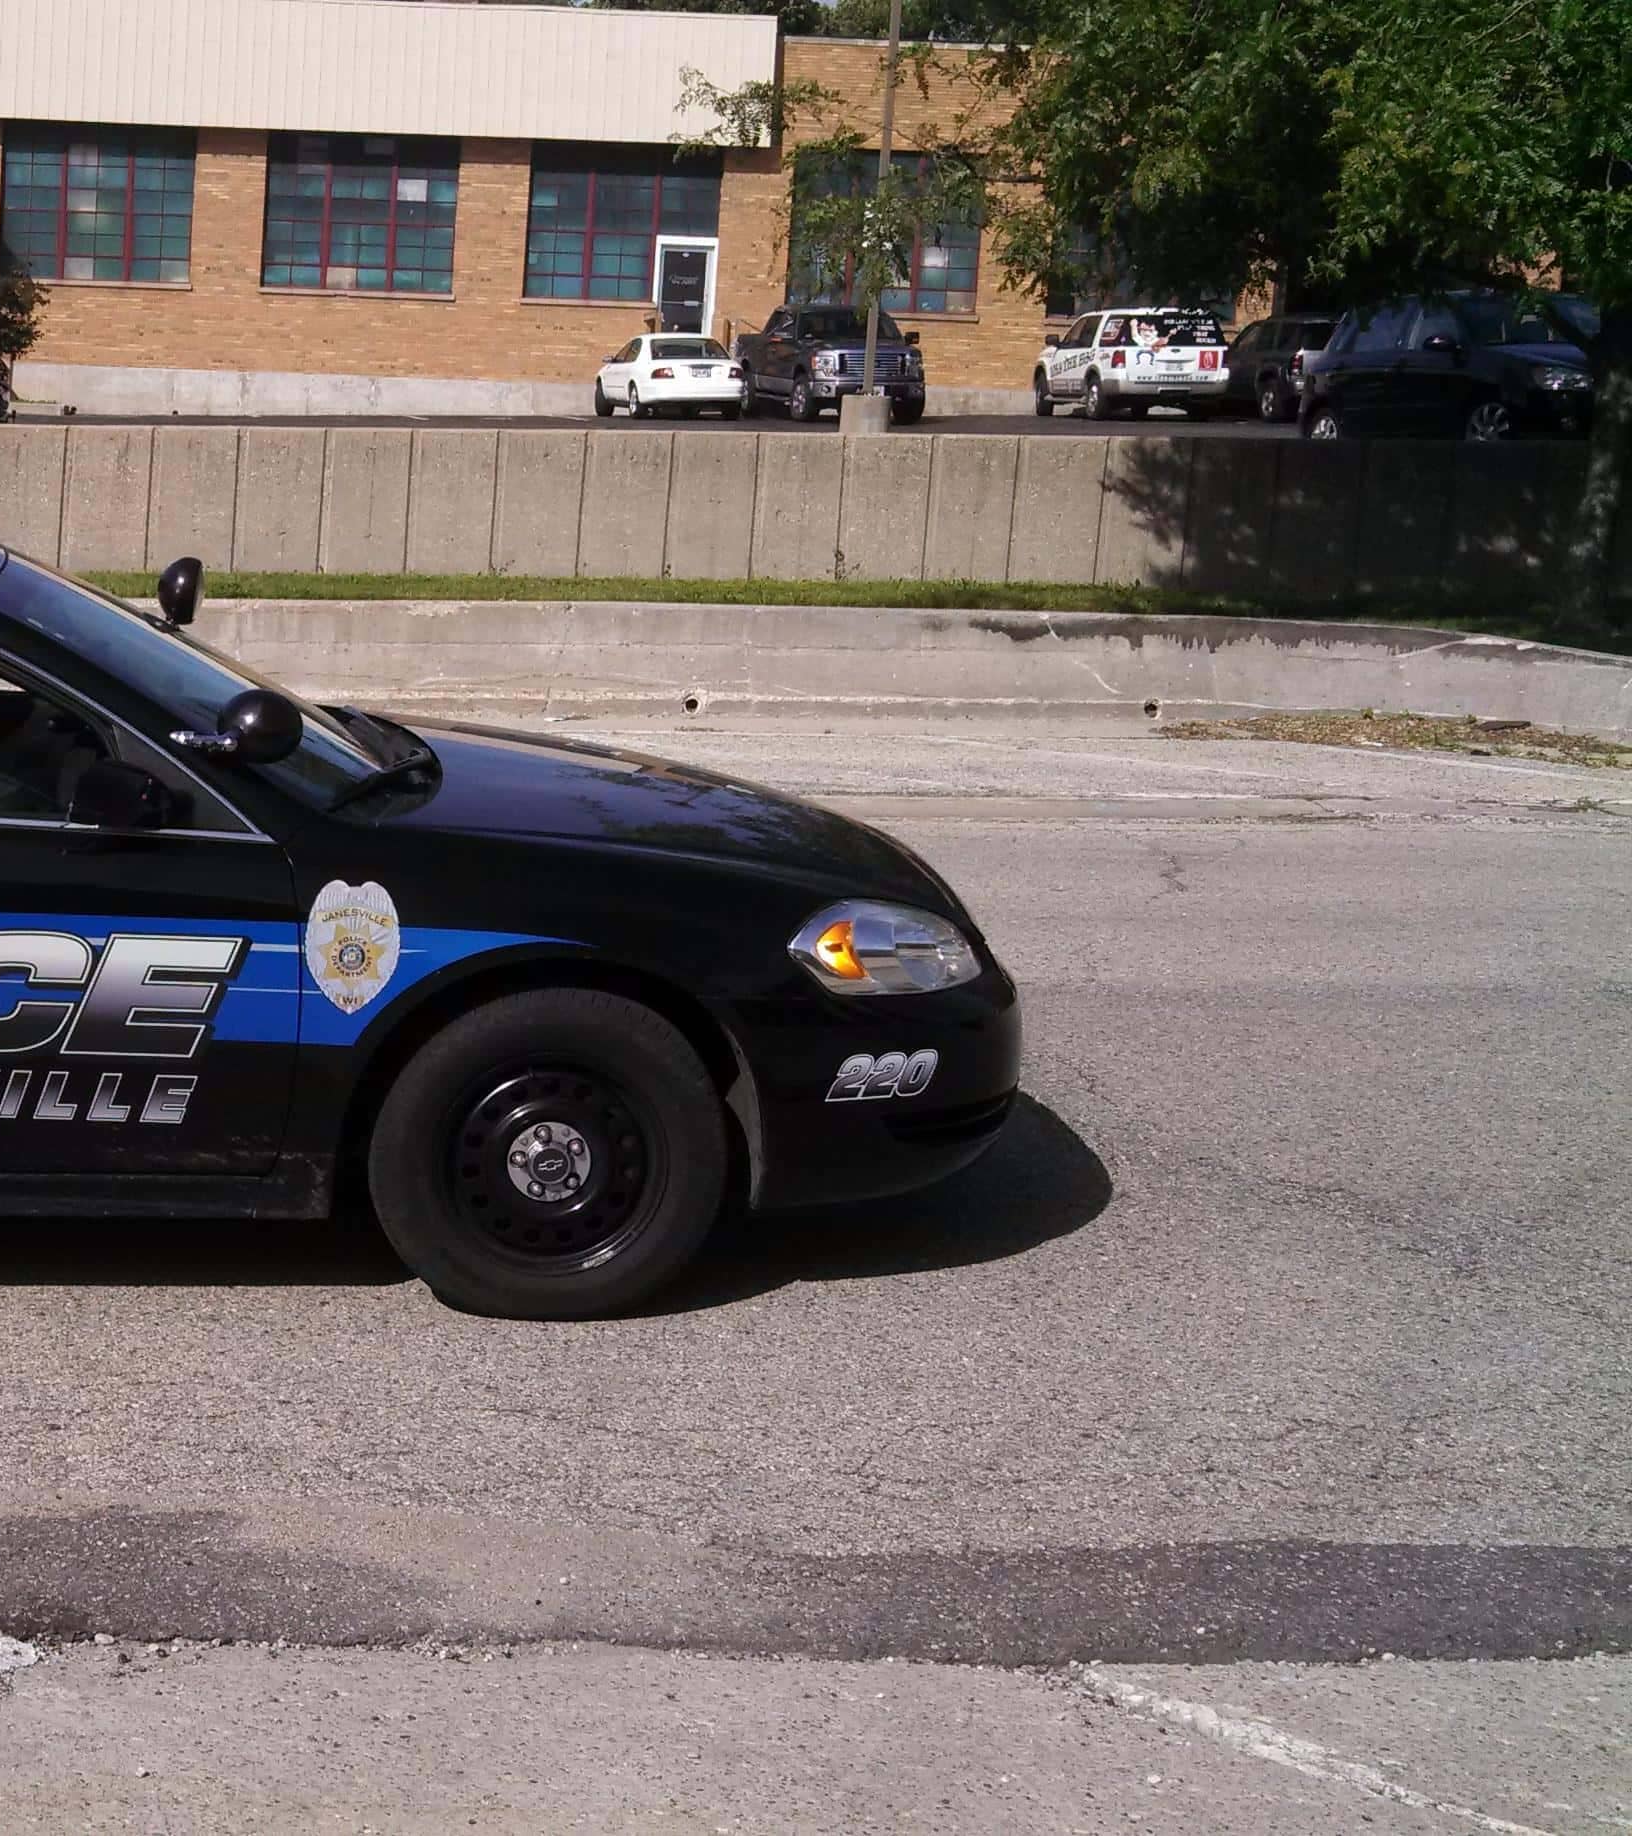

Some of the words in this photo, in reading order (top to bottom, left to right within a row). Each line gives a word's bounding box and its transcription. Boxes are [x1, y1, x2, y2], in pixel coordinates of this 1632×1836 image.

[322, 908, 388, 927] JANESVILLE
[338, 936, 367, 947] POLICE
[331, 955, 372, 977] DEPARTMENT
[342, 996, 358, 1005] WI
[825, 1049, 938, 1101] 220
